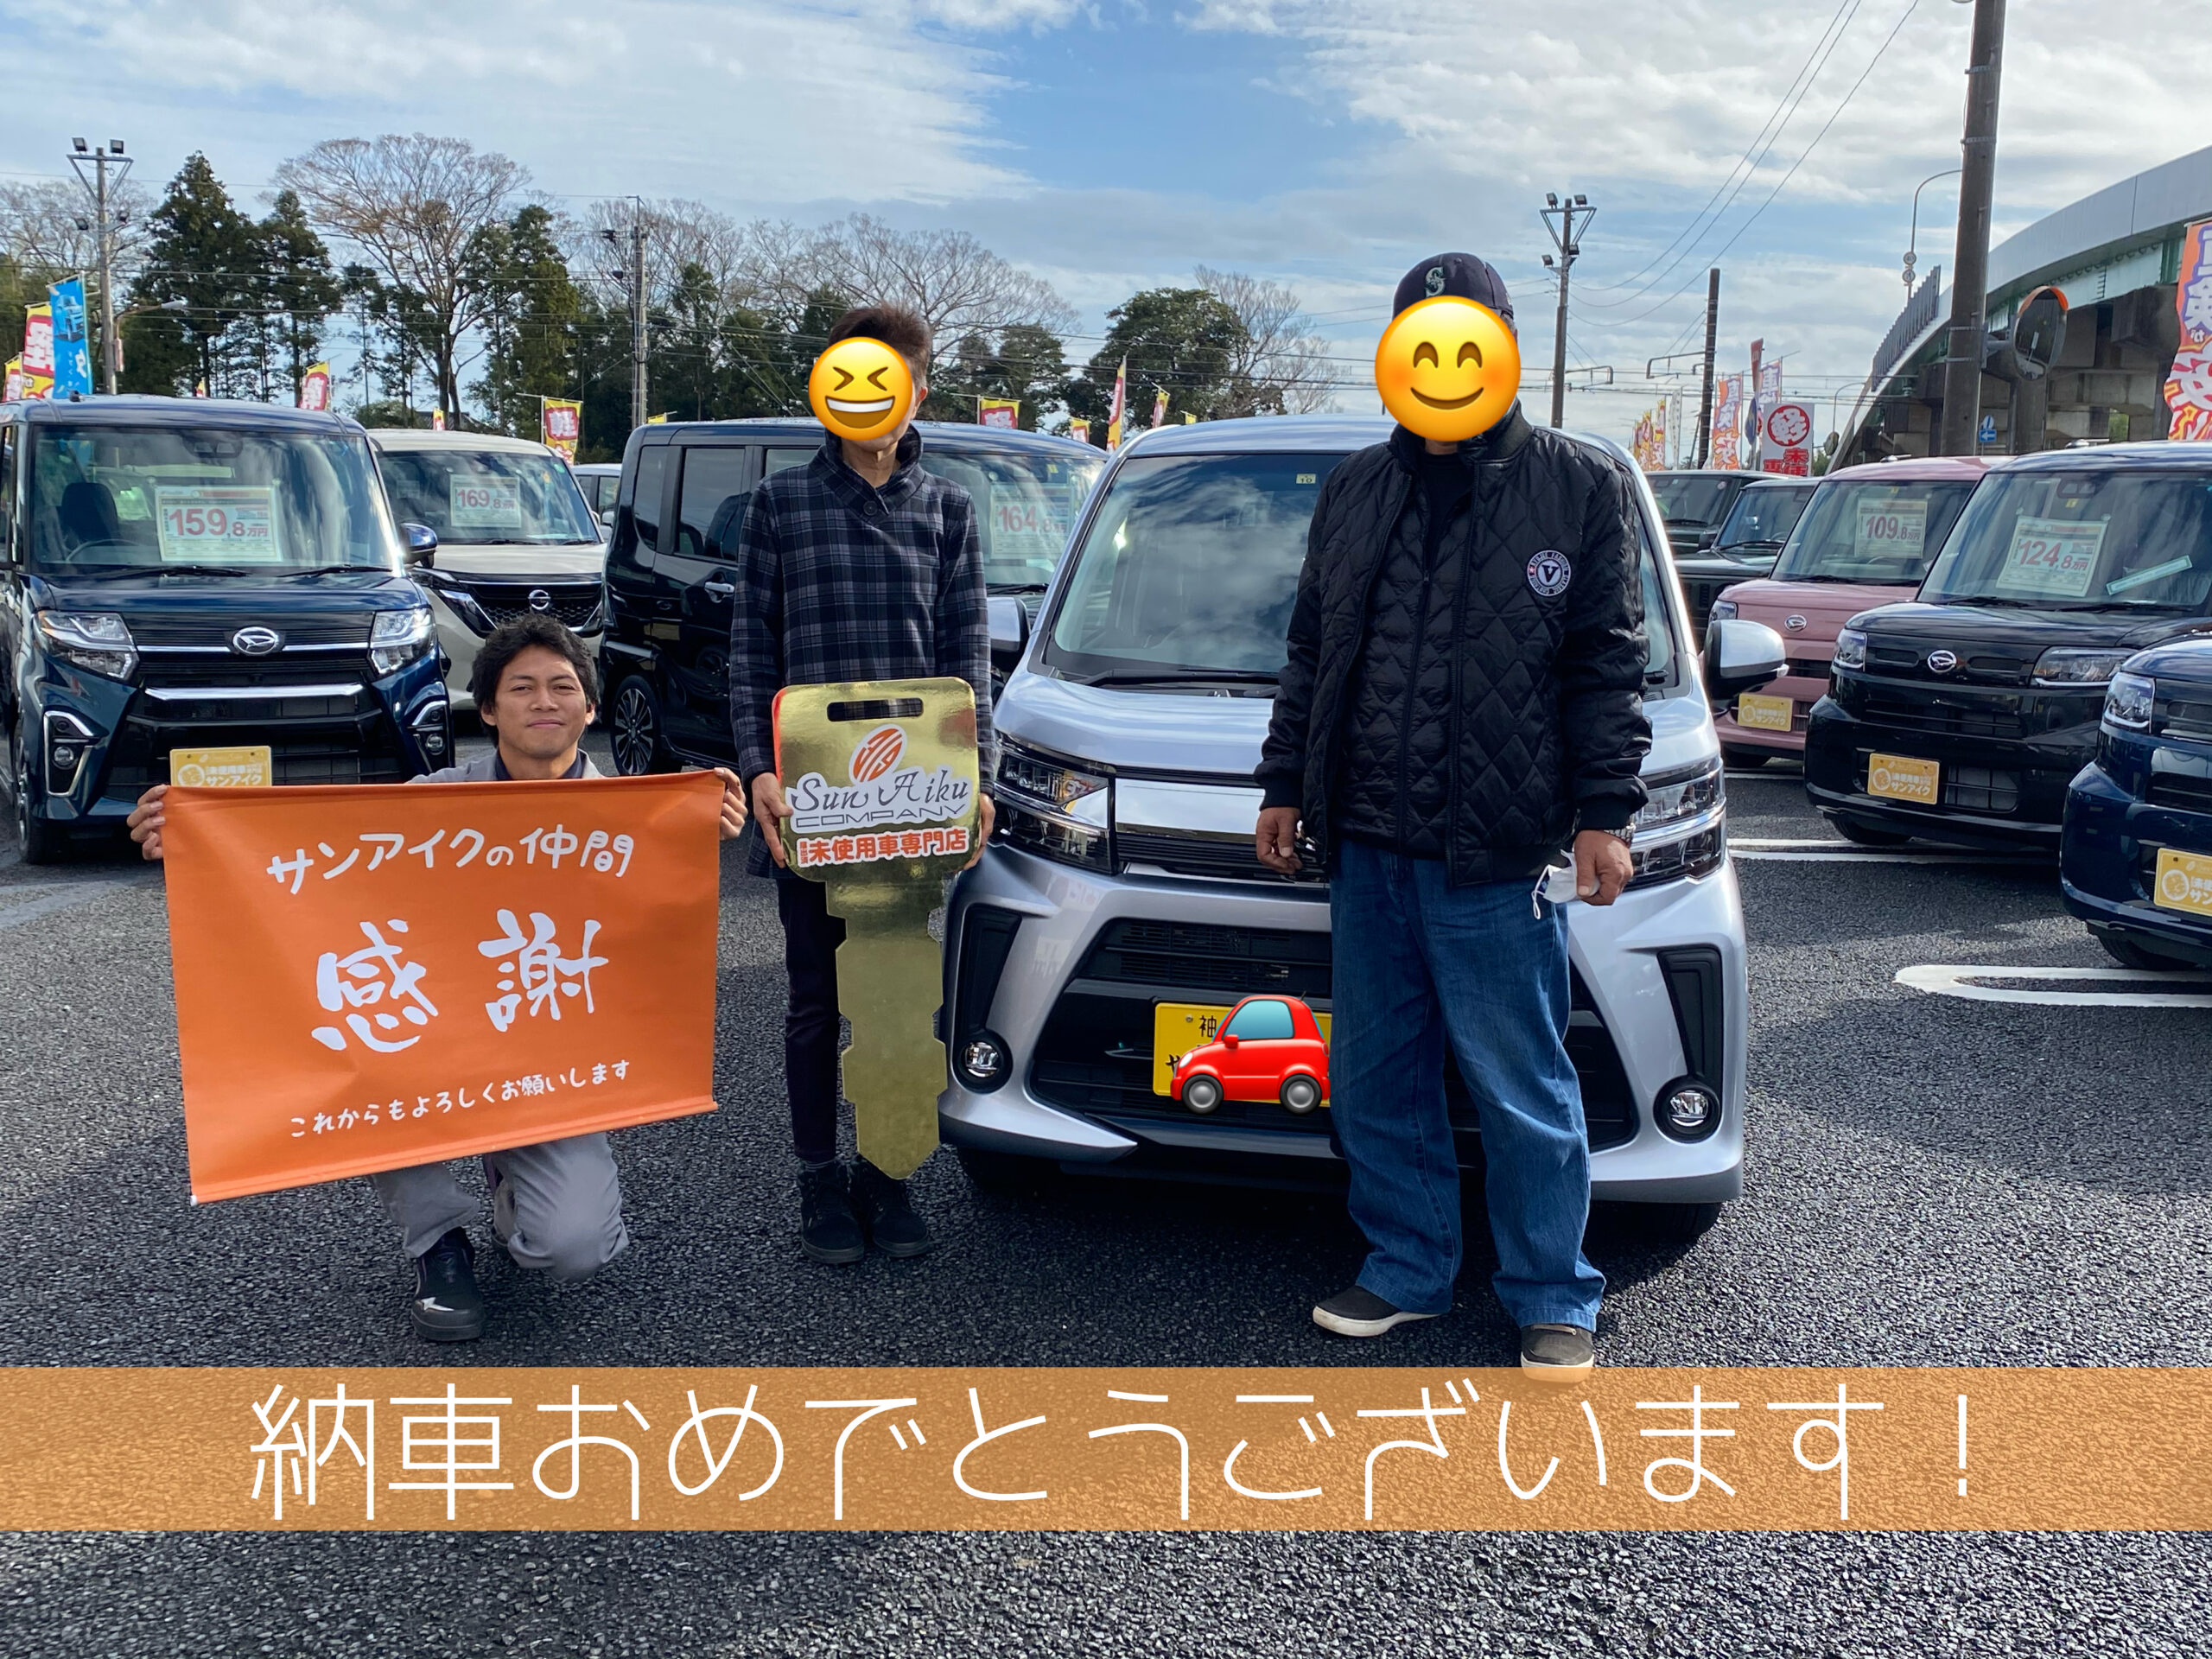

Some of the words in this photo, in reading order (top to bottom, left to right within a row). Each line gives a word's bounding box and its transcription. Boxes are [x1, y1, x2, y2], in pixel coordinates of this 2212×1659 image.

[1541, 564, 1560, 583] V
[790, 777, 870, 812] Sun
[878, 769, 969, 807] Aiku
[796, 803, 966, 829] COMPANY
[266, 823, 634, 895] サンアイクの仲間
[809, 828, 967, 863] 未使用車専門店
[311, 908, 609, 1053] 感謝
[290, 1059, 630, 1137] これからもよろしくお願いします
